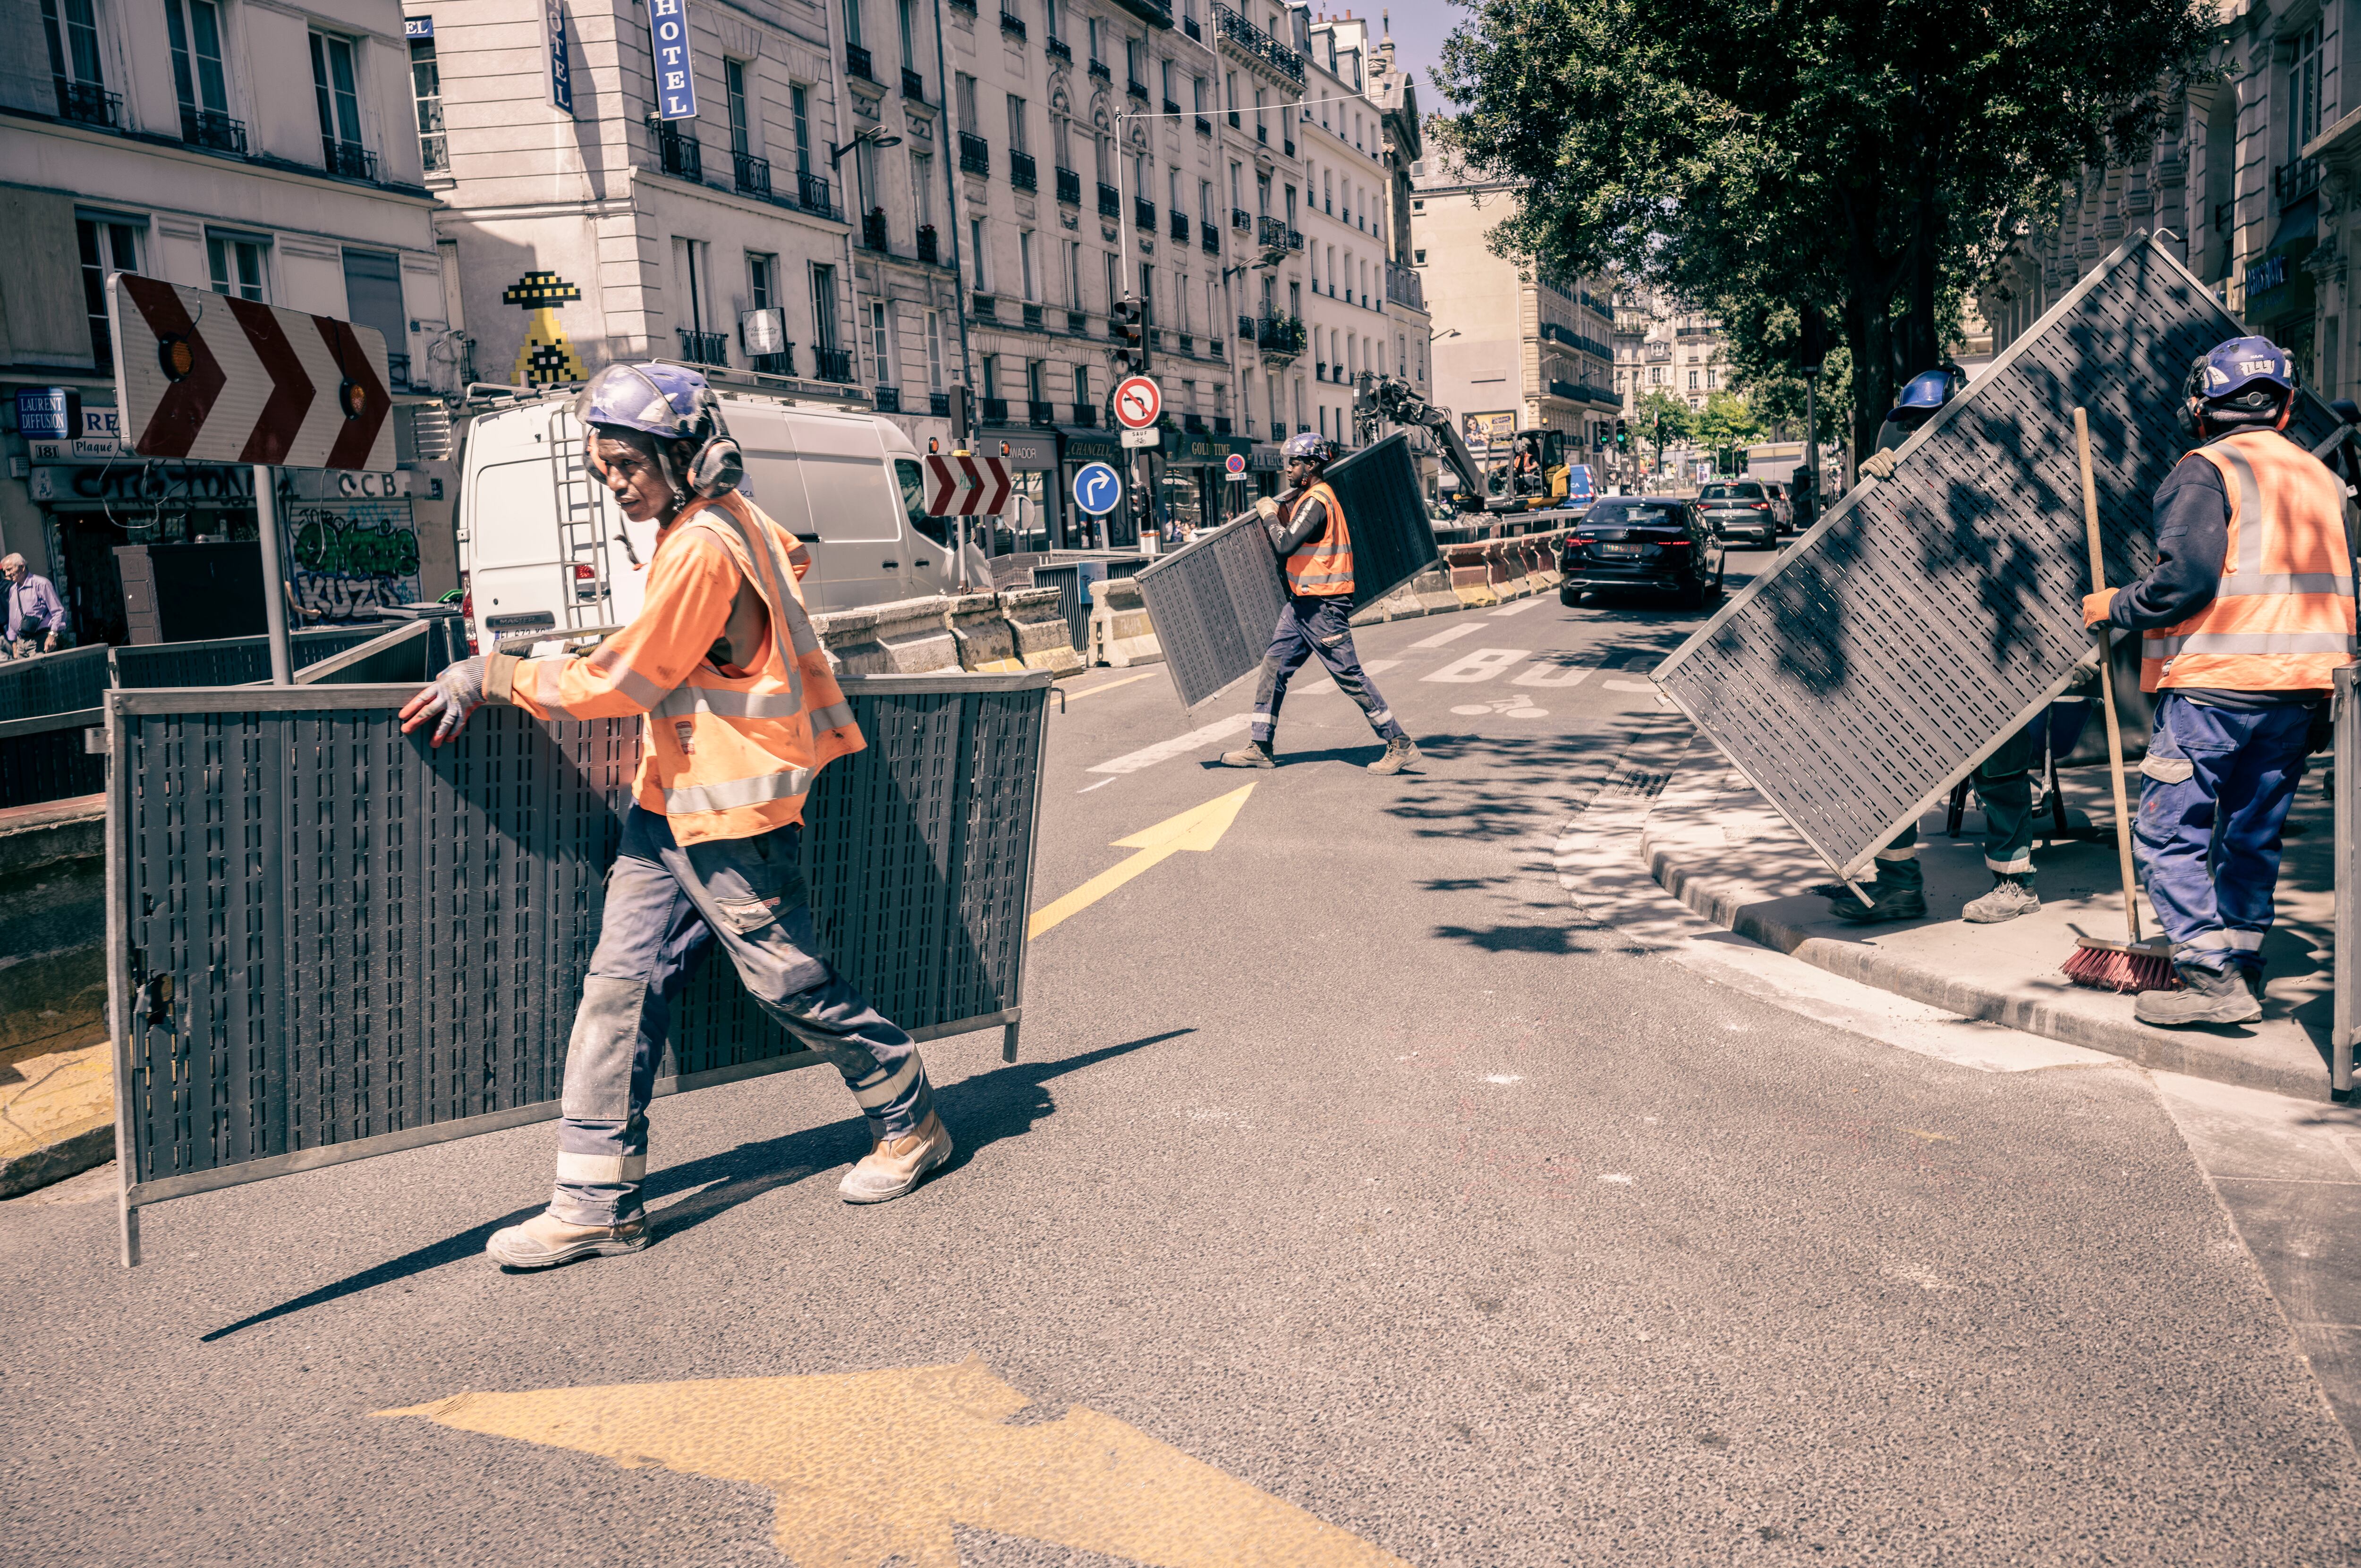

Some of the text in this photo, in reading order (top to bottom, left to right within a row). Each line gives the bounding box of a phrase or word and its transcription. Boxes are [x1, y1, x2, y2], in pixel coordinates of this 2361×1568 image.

[655, 0, 688, 114] HOTEL
[2233, 357, 2276, 377] BILLY
[21, 397, 62, 411] LAURENT
[22, 413, 64, 429] DIFFUSION
[38, 445, 58, 458] 181
[76, 441, 112, 452] Plaqué
[1071, 442, 1111, 457] CHANCELY
[1214, 443, 1231, 456] TIME
[500, 617, 535, 626] MASTER
